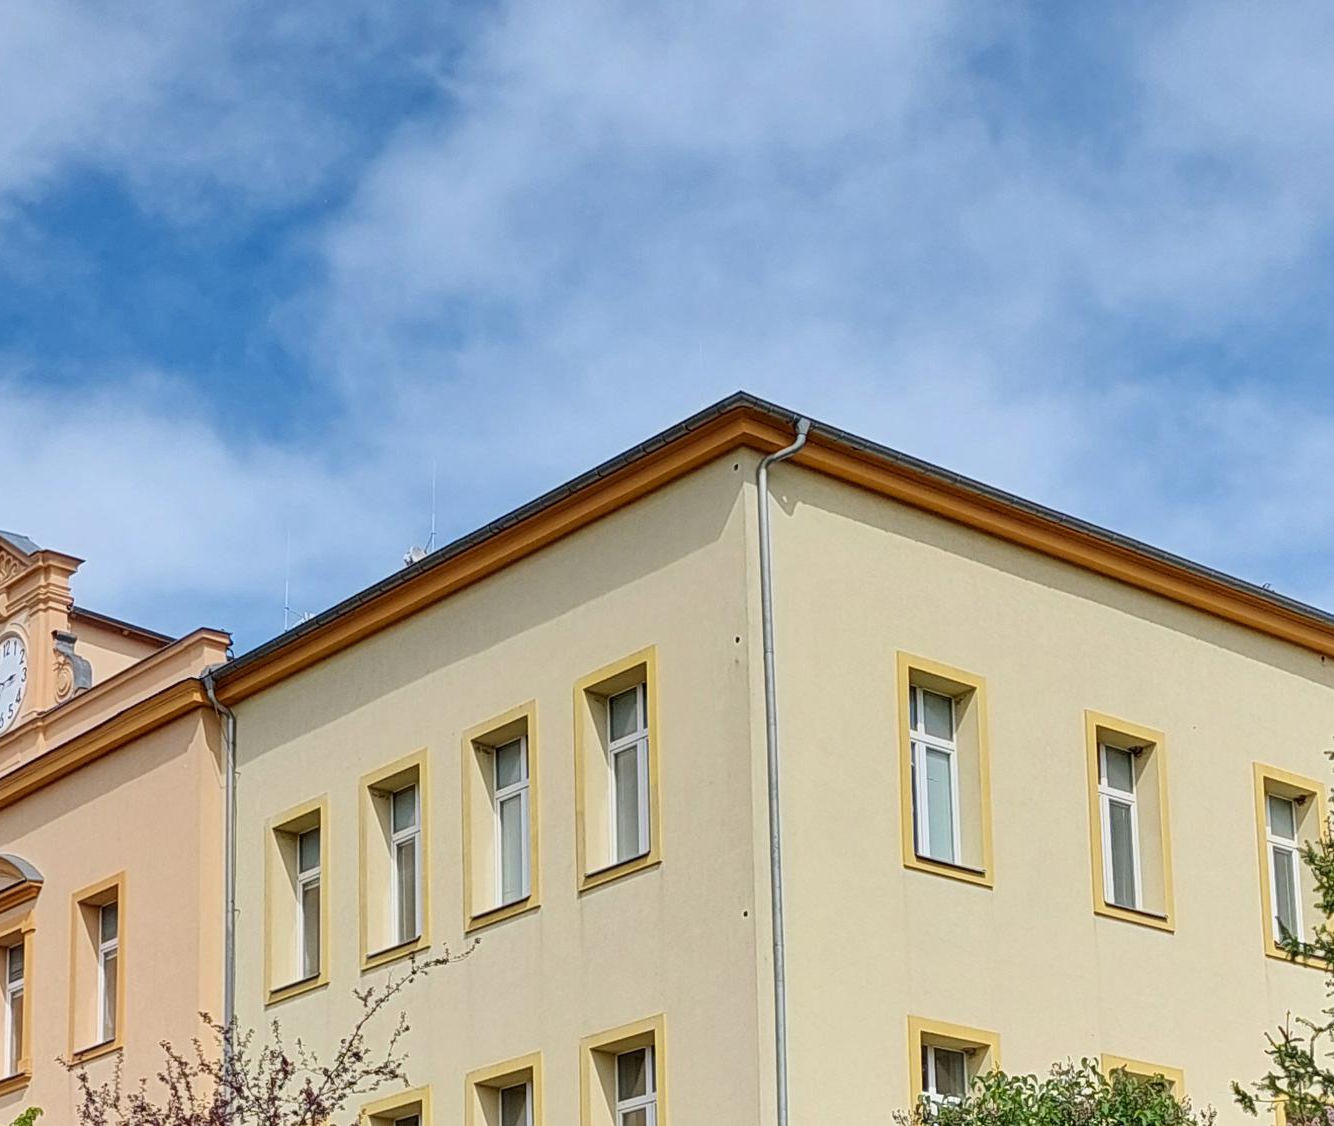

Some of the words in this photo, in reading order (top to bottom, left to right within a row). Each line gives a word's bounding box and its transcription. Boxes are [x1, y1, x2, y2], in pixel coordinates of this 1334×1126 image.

[3, 640, 10, 658] 12
[14, 641, 17, 656] 1
[20, 649, 25, 665] 2
[21, 667, 27, 682] 3
[16, 688, 21, 704] 4
[8, 703, 13, 719] 5
